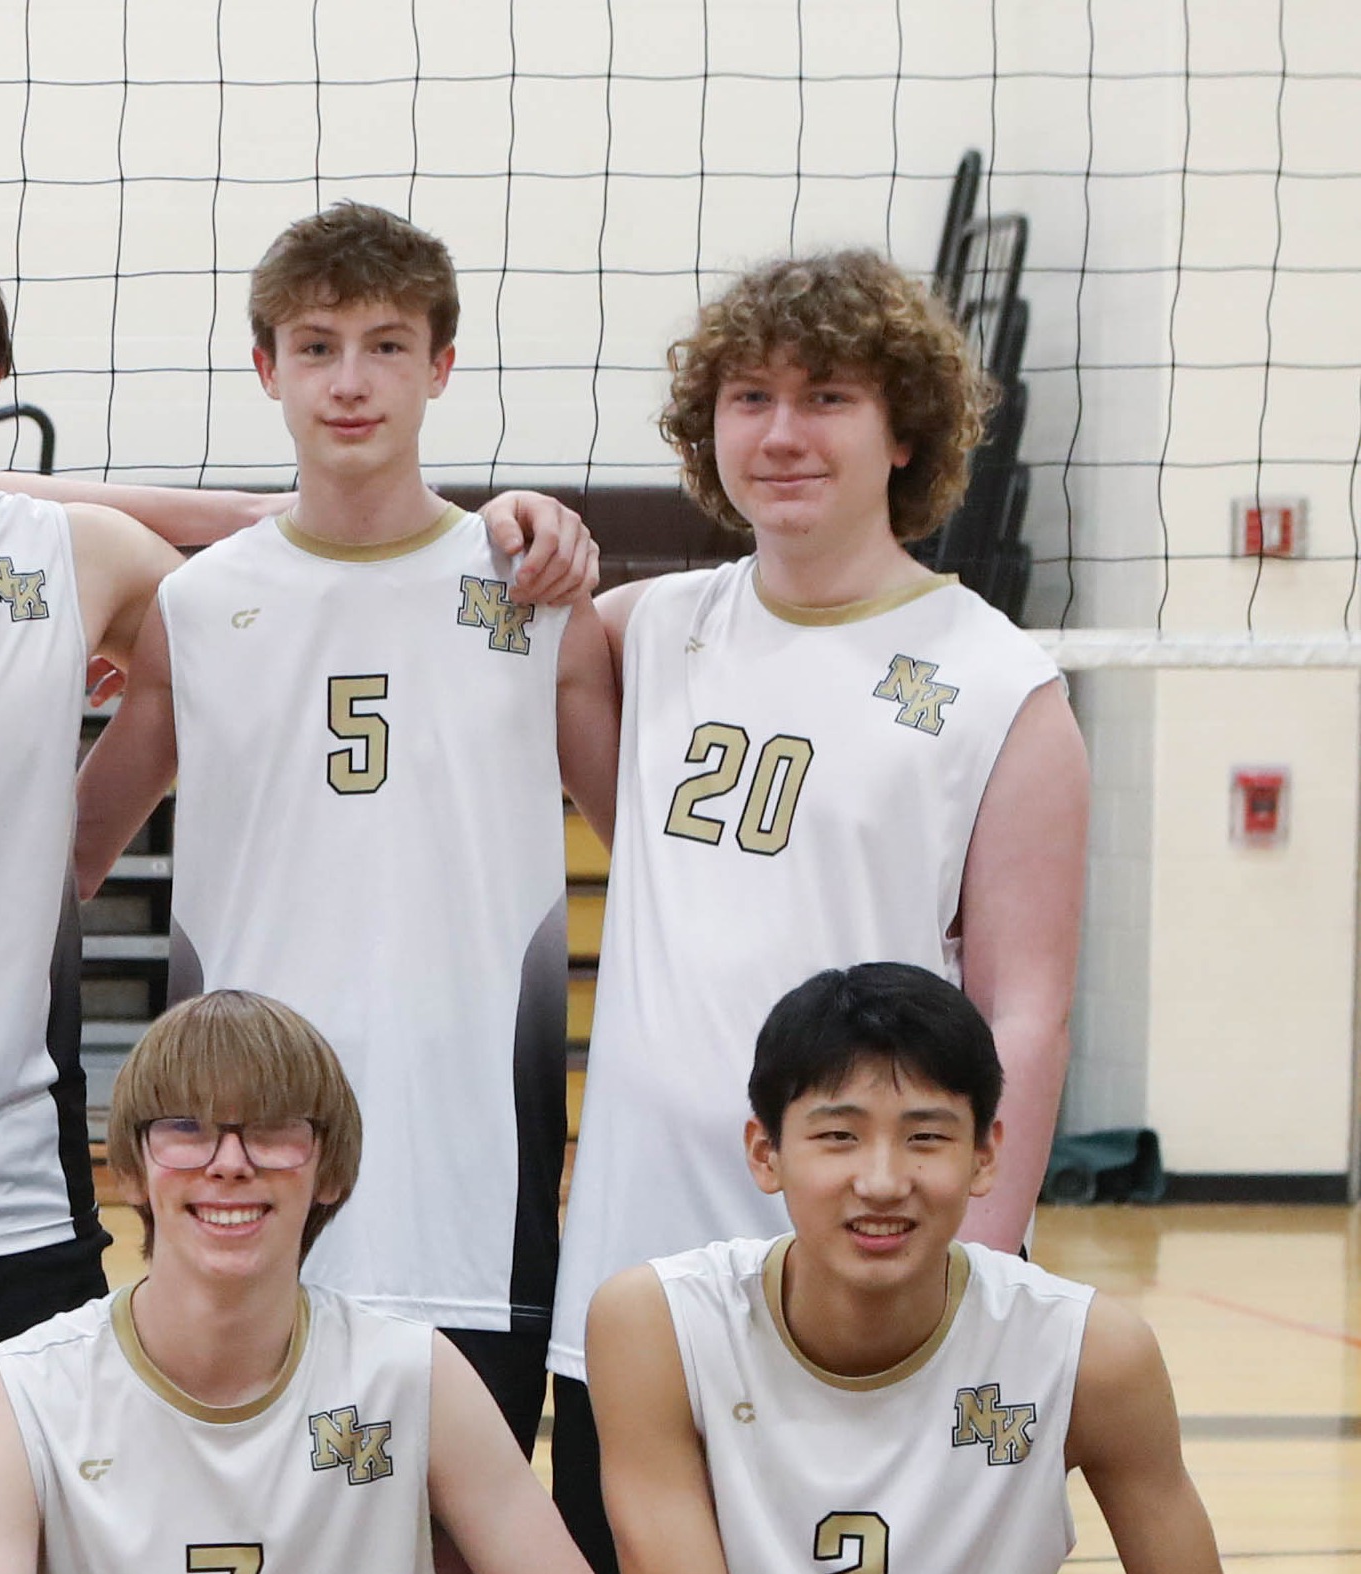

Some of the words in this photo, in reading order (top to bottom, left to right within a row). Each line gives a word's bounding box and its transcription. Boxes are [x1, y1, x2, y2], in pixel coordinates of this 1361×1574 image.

[457, 574, 535, 656] NK
[327, 673, 389, 795] 5
[873, 653, 959, 736] NK
[663, 720, 814, 857] 20
[308, 1404, 393, 1486] NK
[952, 1383, 1037, 1466] NK
